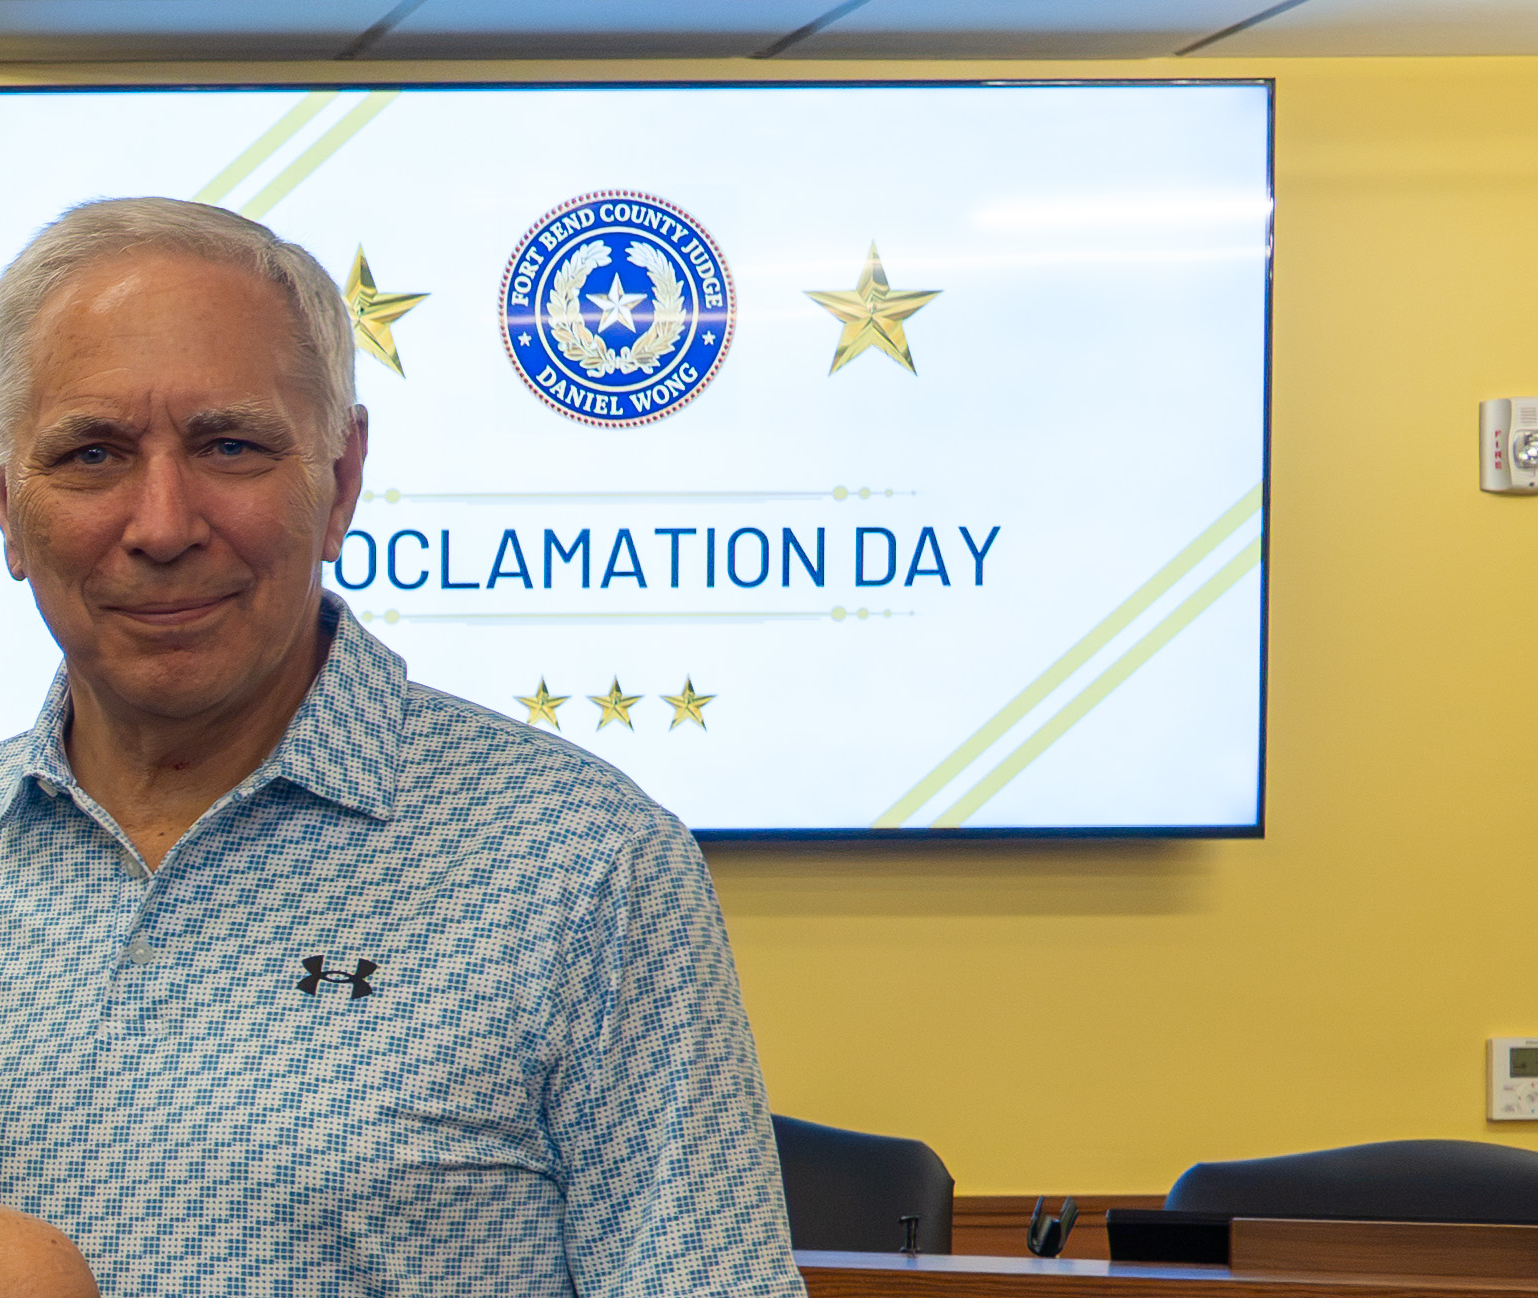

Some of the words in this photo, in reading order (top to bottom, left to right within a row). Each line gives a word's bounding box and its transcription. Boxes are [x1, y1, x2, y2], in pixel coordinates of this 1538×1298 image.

[511, 246, 544, 307] FORT
[539, 208, 595, 252] BEND
[599, 203, 689, 243] COUNTY
[681, 238, 724, 309] JUDGE
[535, 365, 624, 416] DANIEL
[629, 362, 699, 413] WONG
[335, 526, 825, 590] OCLAMATION
[854, 526, 1001, 588] DAY
